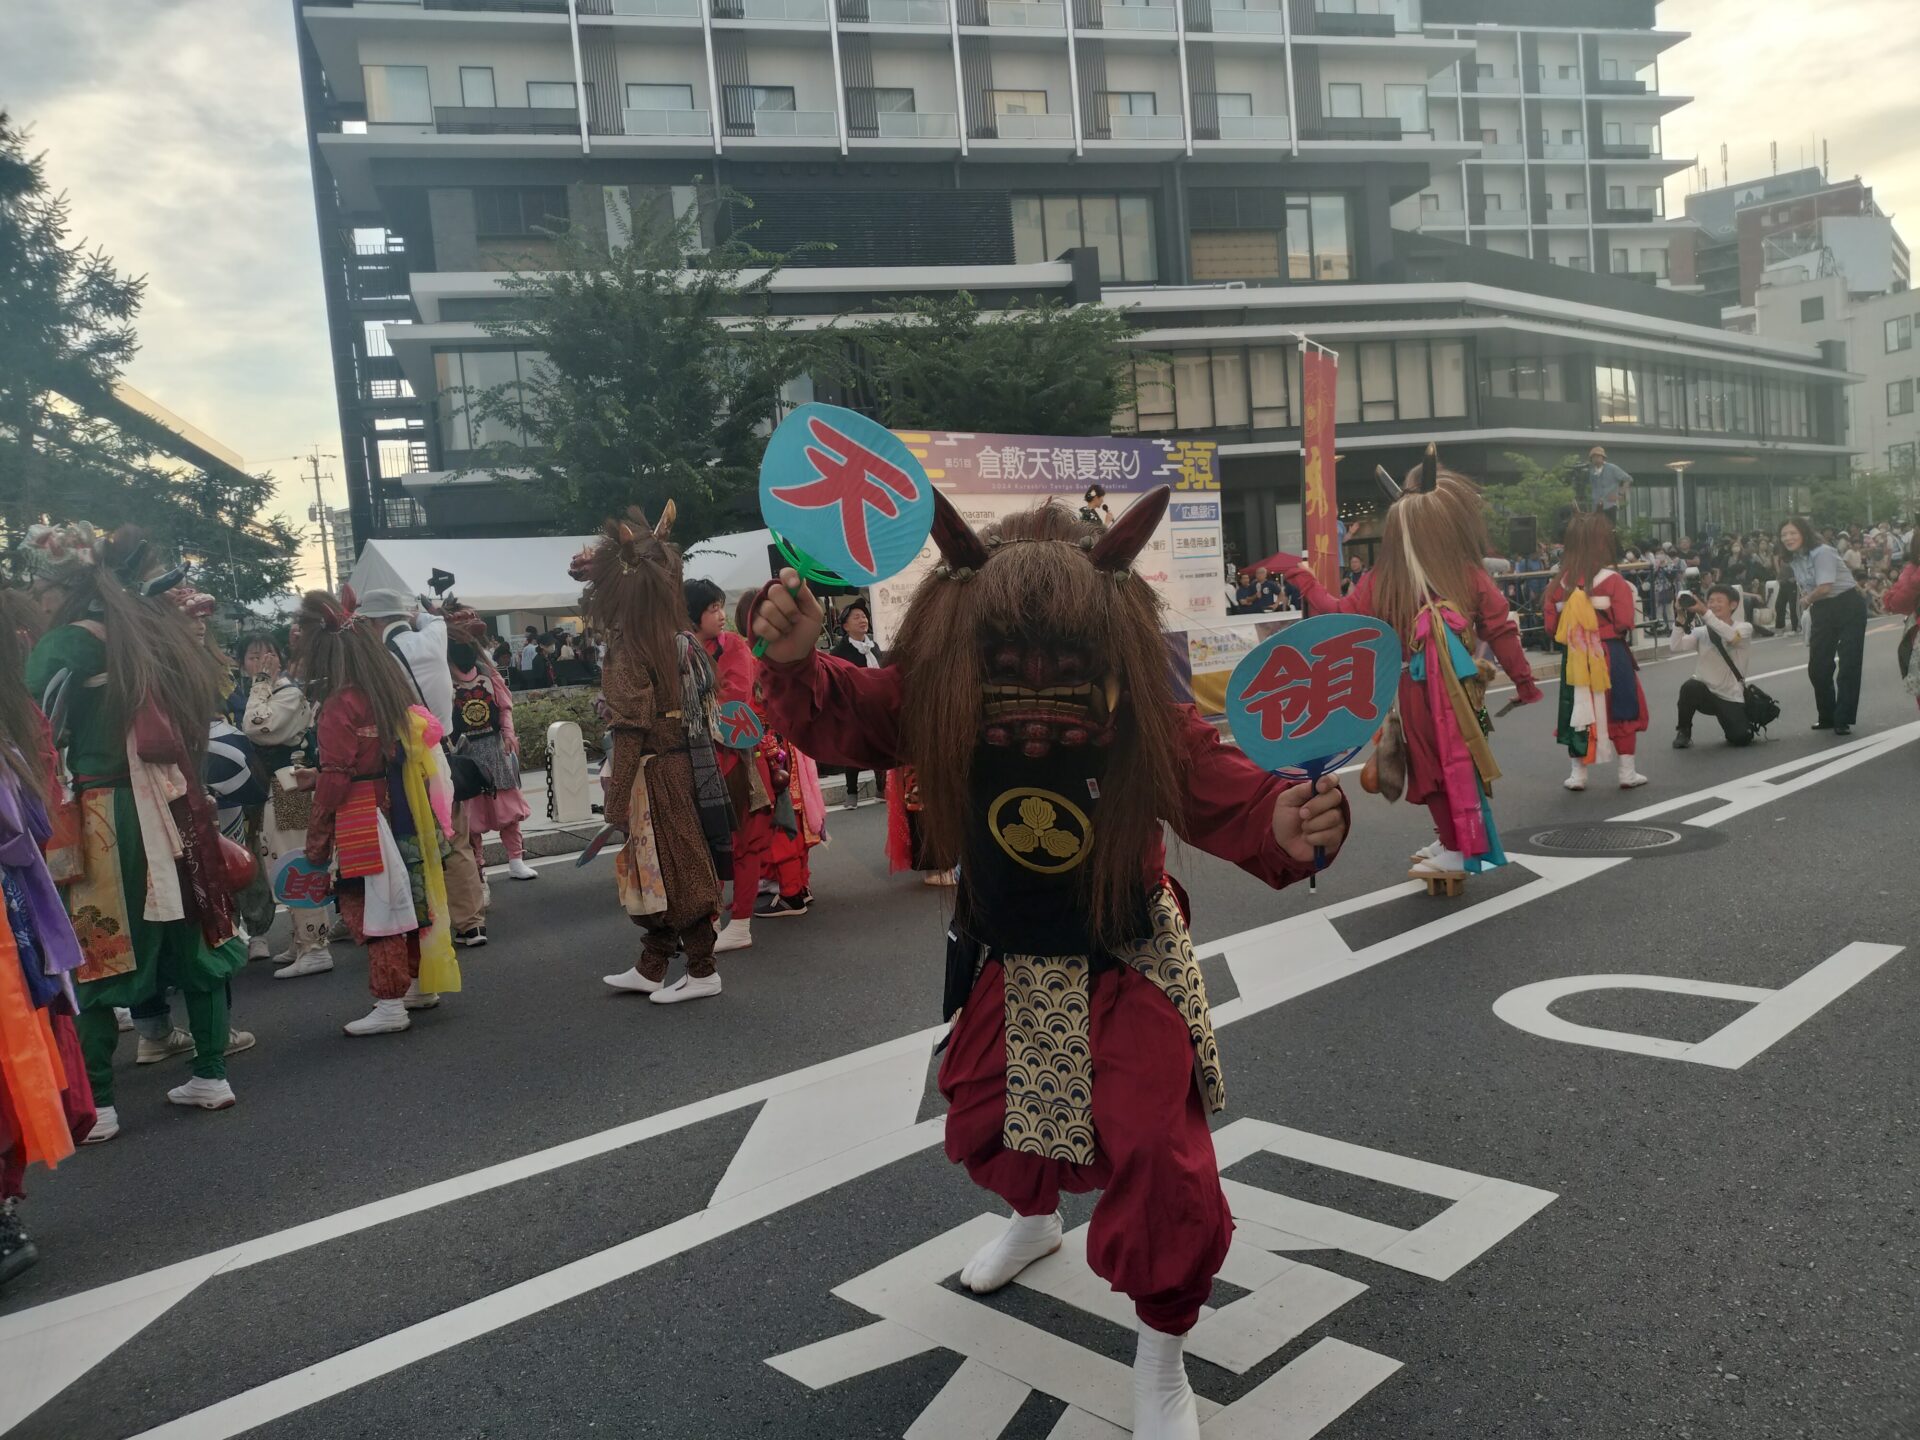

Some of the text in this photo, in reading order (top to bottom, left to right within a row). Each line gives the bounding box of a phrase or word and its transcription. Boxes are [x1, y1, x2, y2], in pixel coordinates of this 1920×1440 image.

[769, 416, 920, 576] 天
[976, 445, 1140, 480] 倉敷天領夏祭り
[1239, 628, 1383, 741] 領
